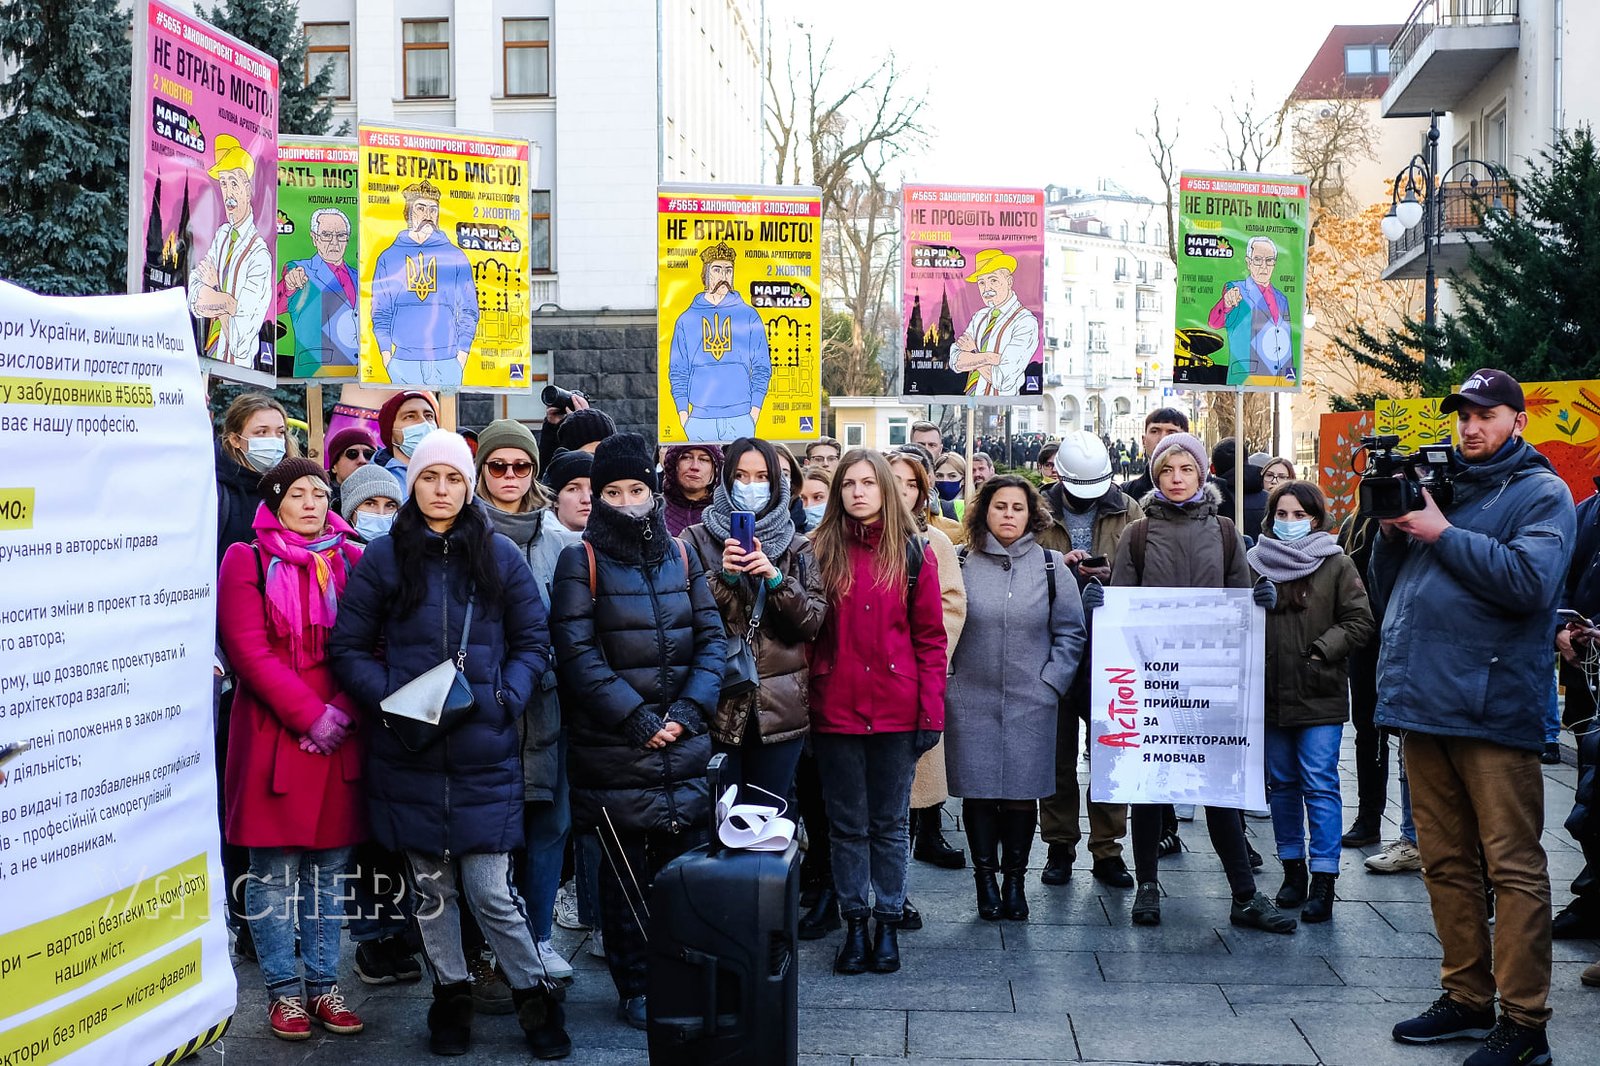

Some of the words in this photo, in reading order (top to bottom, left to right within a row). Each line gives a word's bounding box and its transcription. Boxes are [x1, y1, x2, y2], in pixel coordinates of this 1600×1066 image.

[155, 10, 182, 36] #5655
[234, 46, 272, 81] ЗЛОБУДОВИ
[154, 36, 171, 71] НЕ
[177, 48, 225, 97] ВТРАТЬ
[230, 74, 273, 119] МІСТО!
[153, 74, 159, 91] 2
[160, 77, 194, 106] ЖОВТНЯ
[156, 104, 188, 128] МАРШ
[156, 122, 173, 141] ЗА
[175, 130, 205, 152] КИЇВ
[369, 133, 400, 146] #5655
[469, 143, 518, 158] ЗЛОБУДОВИ
[368, 153, 389, 176] НЕ
[396, 154, 458, 181] ВТРАТЬ
[465, 162, 521, 186] МІСТО!
[450, 189, 475, 200] КОЛОНА
[1187, 179, 1210, 189] #5655
[1261, 185, 1298, 196] ЗЛОБУДОВИ
[308, 196, 333, 204] КОЛОНА
[668, 199, 698, 211] #5655
[764, 202, 810, 216] ЗЛОБУДОВИ
[912, 191, 937, 201] #5655
[994, 193, 1035, 205] ЗЛОБУДОВИ
[1185, 196, 1201, 214] НЕ
[1206, 198, 1252, 217] ВТРАТЬ
[1257, 201, 1300, 219] МІСТО!
[473, 206, 479, 218] 2
[482, 207, 520, 221] ЖОВТНЯ
[911, 209, 926, 225] НЕ
[1000, 211, 1037, 227] МІСТО
[461, 227, 498, 238] МАРШ
[667, 219, 688, 240] НЕ
[694, 219, 753, 241] ВТРАТЬ
[760, 221, 813, 243] МІСТО!
[1184, 219, 1190, 228] 2
[462, 239, 482, 249] ЗА
[484, 240, 520, 251] КИЇВ
[911, 231, 916, 241] 2
[1188, 238, 1216, 246] МАРШ
[744, 249, 769, 258] КОЛОНА
[771, 250, 811, 260] АРХІТЕКТОРІВ
[915, 249, 947, 257] МАРШ
[1188, 247, 1202, 255] ЗА
[1206, 249, 1233, 257] КИЇВ
[767, 265, 772, 276] 2
[775, 265, 811, 277] ЖОВТНЯ
[915, 259, 931, 267] ЗА
[934, 259, 965, 268] КИЇВ
[754, 285, 790, 296] МАРШ
[755, 297, 773, 306] ЗА
[776, 297, 810, 307] КИЇВ
[0, 321, 24, 340] ри
[29, 318, 90, 345] України,
[93, 327, 140, 346] вийшли
[141, 336, 155, 349] на
[156, 332, 184, 352] Марш
[84, 358, 130, 376] протест
[131, 361, 163, 379] проти
[17, 381, 112, 405] забудовників
[116, 386, 156, 407] #5655,
[159, 388, 184, 405] який
[1, 416, 28, 431] ває
[33, 416, 73, 436] нашу
[76, 414, 139, 436] професію.
[56, 541, 62, 554] в
[66, 533, 123, 556] авторські
[125, 535, 158, 554] права
[0, 607, 47, 624] носити
[51, 601, 84, 618] зміни
[88, 600, 94, 613] в
[98, 595, 136, 614] проект
[140, 592, 151, 606] та
[153, 583, 210, 607] збудований
[18, 631, 66, 650] автора;
[33, 670, 51, 686] що
[54, 659, 109, 683] дозволяє
[112, 648, 177, 672] проектувати
[180, 643, 186, 658] й
[1144, 662, 1179, 672] КОЛИ
[1144, 680, 1179, 690] ВОНИ
[9, 689, 83, 718] архітектора
[86, 678, 130, 701] взагалі;
[1144, 696, 1210, 709] ПРИЙШЛИ
[58, 716, 123, 743] положення
[125, 715, 132, 729] в
[134, 707, 163, 726] закон
[165, 703, 182, 721] про
[1143, 717, 1159, 726] ЗА
[1143, 735, 1250, 748] АРХІТЕКТОРАМИ,
[1143, 753, 1151, 763] Я
[1153, 753, 1206, 763] МОВЧАВ
[14, 752, 82, 784] діяльність;
[0, 808, 17, 823] во
[20, 791, 62, 818] видачі
[65, 791, 78, 805] та
[80, 770, 151, 800] позбавлення
[152, 752, 201, 780] сертифікатів
[23, 809, 98, 846] професійній
[100, 784, 172, 821] саморегулівній
[11, 863, 18, 876] а
[22, 857, 37, 872] не
[41, 832, 117, 863] чиновникам.
[47, 924, 96, 957] вартові
[99, 904, 145, 935] безпеки
[147, 897, 159, 912] та
[160, 873, 206, 907] комфорту
[55, 955, 98, 984] наших
[101, 939, 125, 965] міст.
[53, 1027, 75, 1047] без
[79, 1008, 108, 1034] прав
[126, 960, 196, 1009] міста-фавели
